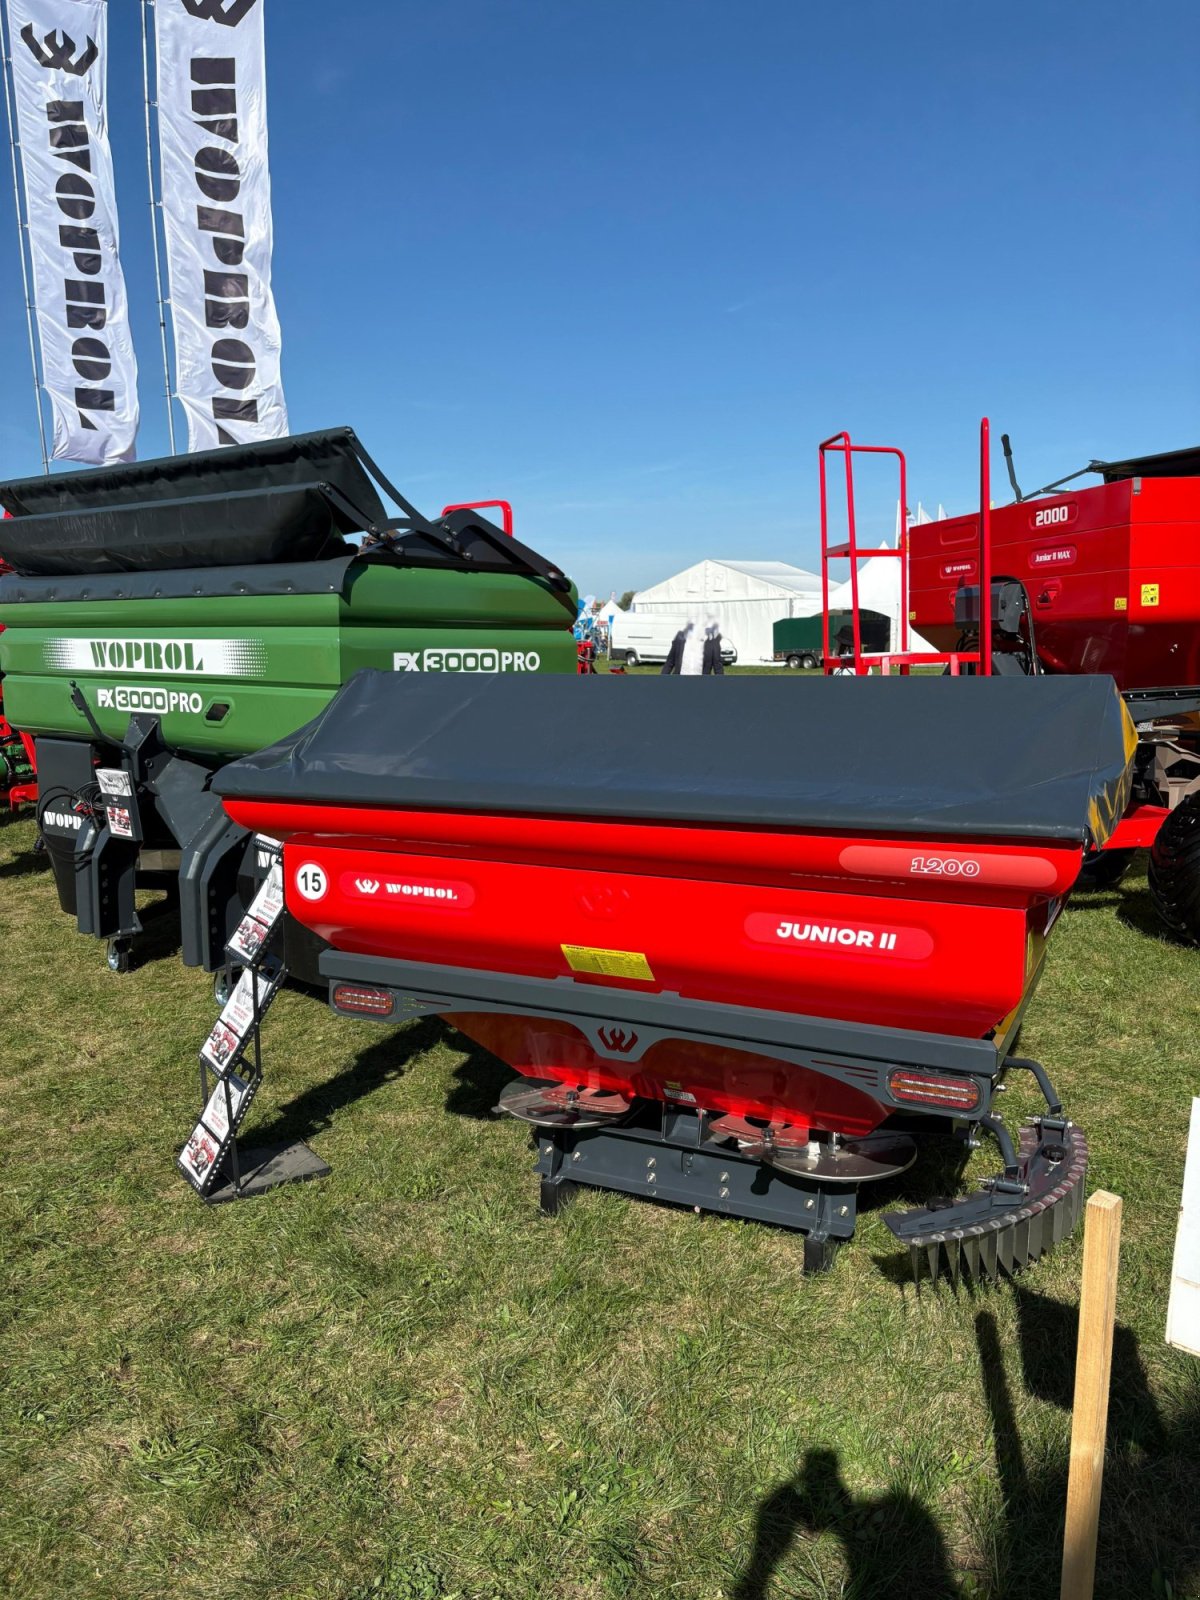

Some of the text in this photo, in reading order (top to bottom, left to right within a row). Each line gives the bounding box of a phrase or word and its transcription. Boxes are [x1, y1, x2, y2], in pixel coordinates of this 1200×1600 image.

[190, 57, 259, 445] WOPROL
[47, 100, 115, 430] WOPROL
[1036, 506, 1068, 526] 2000
[1035, 553, 1052, 562] Junior
[1057, 550, 1071, 559] MAX
[90, 641, 204, 671] WOPROL
[425, 652, 497, 671] 3000
[501, 651, 541, 672] PRO
[116, 690, 166, 710] 3000
[169, 692, 202, 714] PRO
[910, 857, 980, 877] 1200
[300, 872, 322, 892] 15
[385, 883, 458, 900] WOPROL
[776, 922, 896, 950] JUNIOR II
